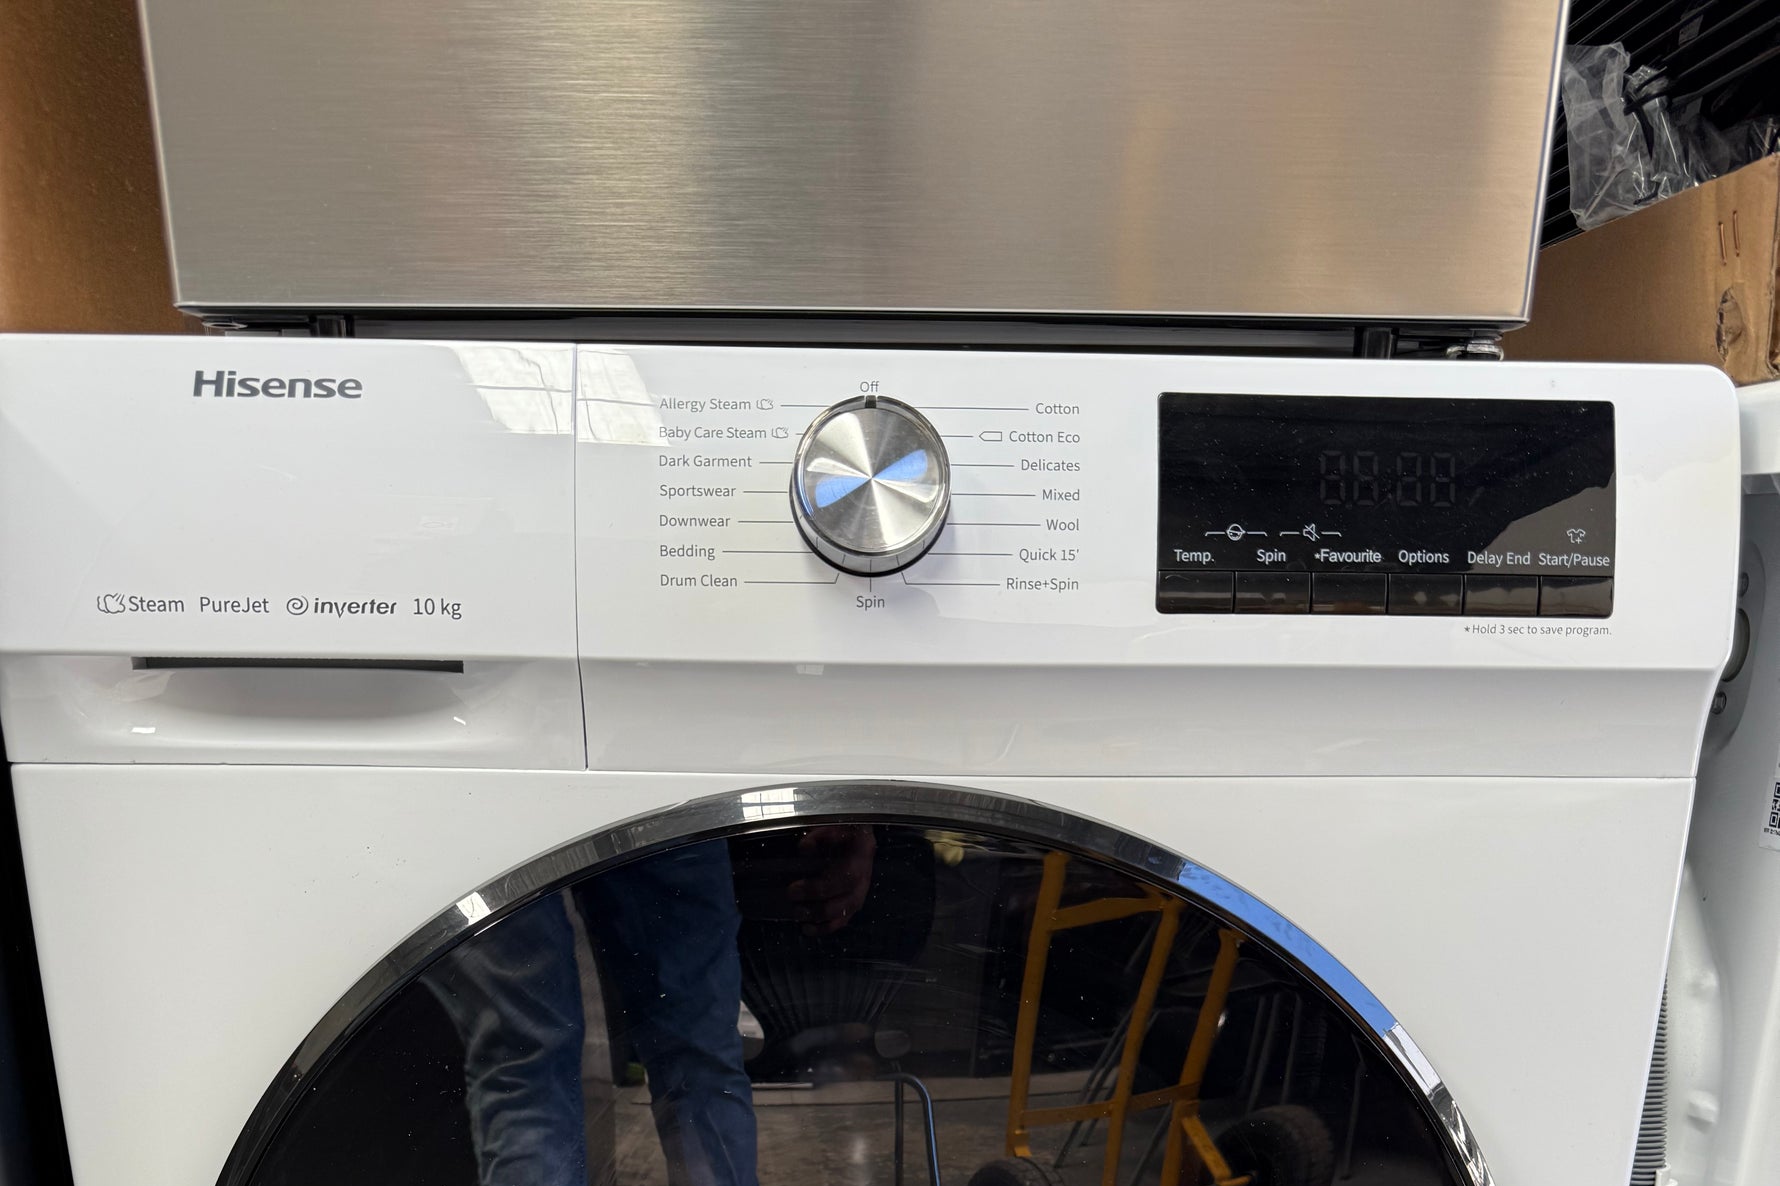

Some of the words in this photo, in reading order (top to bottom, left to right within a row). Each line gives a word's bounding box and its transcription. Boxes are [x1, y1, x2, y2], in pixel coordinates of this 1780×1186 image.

[193, 370, 362, 399] Hisense
[860, 381, 879, 392] Off
[659, 398, 706, 413] Allergy
[710, 399, 751, 411] Steam
[1036, 403, 1079, 414] Cotton
[659, 426, 691, 442] Baby
[694, 427, 723, 439] Care
[726, 427, 767, 439] Steam
[1009, 431, 1053, 442] Cotton
[1058, 432, 1080, 443] Eco
[659, 454, 690, 467] Dark
[694, 455, 752, 467] Garment
[1021, 459, 1080, 471] Delicates
[660, 485, 736, 499] Sportswear
[1043, 489, 1080, 501] Mixed
[660, 515, 730, 527] Downwear
[1046, 518, 1079, 531] Wool
[660, 544, 715, 561] Bedding
[1019, 548, 1057, 563] Quick
[1174, 549, 1214, 565] Temp.
[1257, 549, 1286, 565] Spin
[1399, 550, 1449, 566] Options
[1468, 551, 1503, 567] Delay
[1507, 551, 1531, 565] End
[1539, 553, 1610, 568] Start/Pause
[661, 574, 696, 586] Drum
[701, 574, 737, 587] Clean
[1007, 577, 1078, 593] Rinse+Spin
[129, 596, 184, 612] Steam
[200, 597, 269, 613] PureJet
[314, 598, 397, 618] inverter
[414, 598, 435, 615] 10
[441, 598, 462, 620] kg
[857, 595, 885, 610] Spin
[1499, 625, 1505, 634] 3
[1528, 625, 1537, 634] to
[1564, 627, 1612, 637] program.
